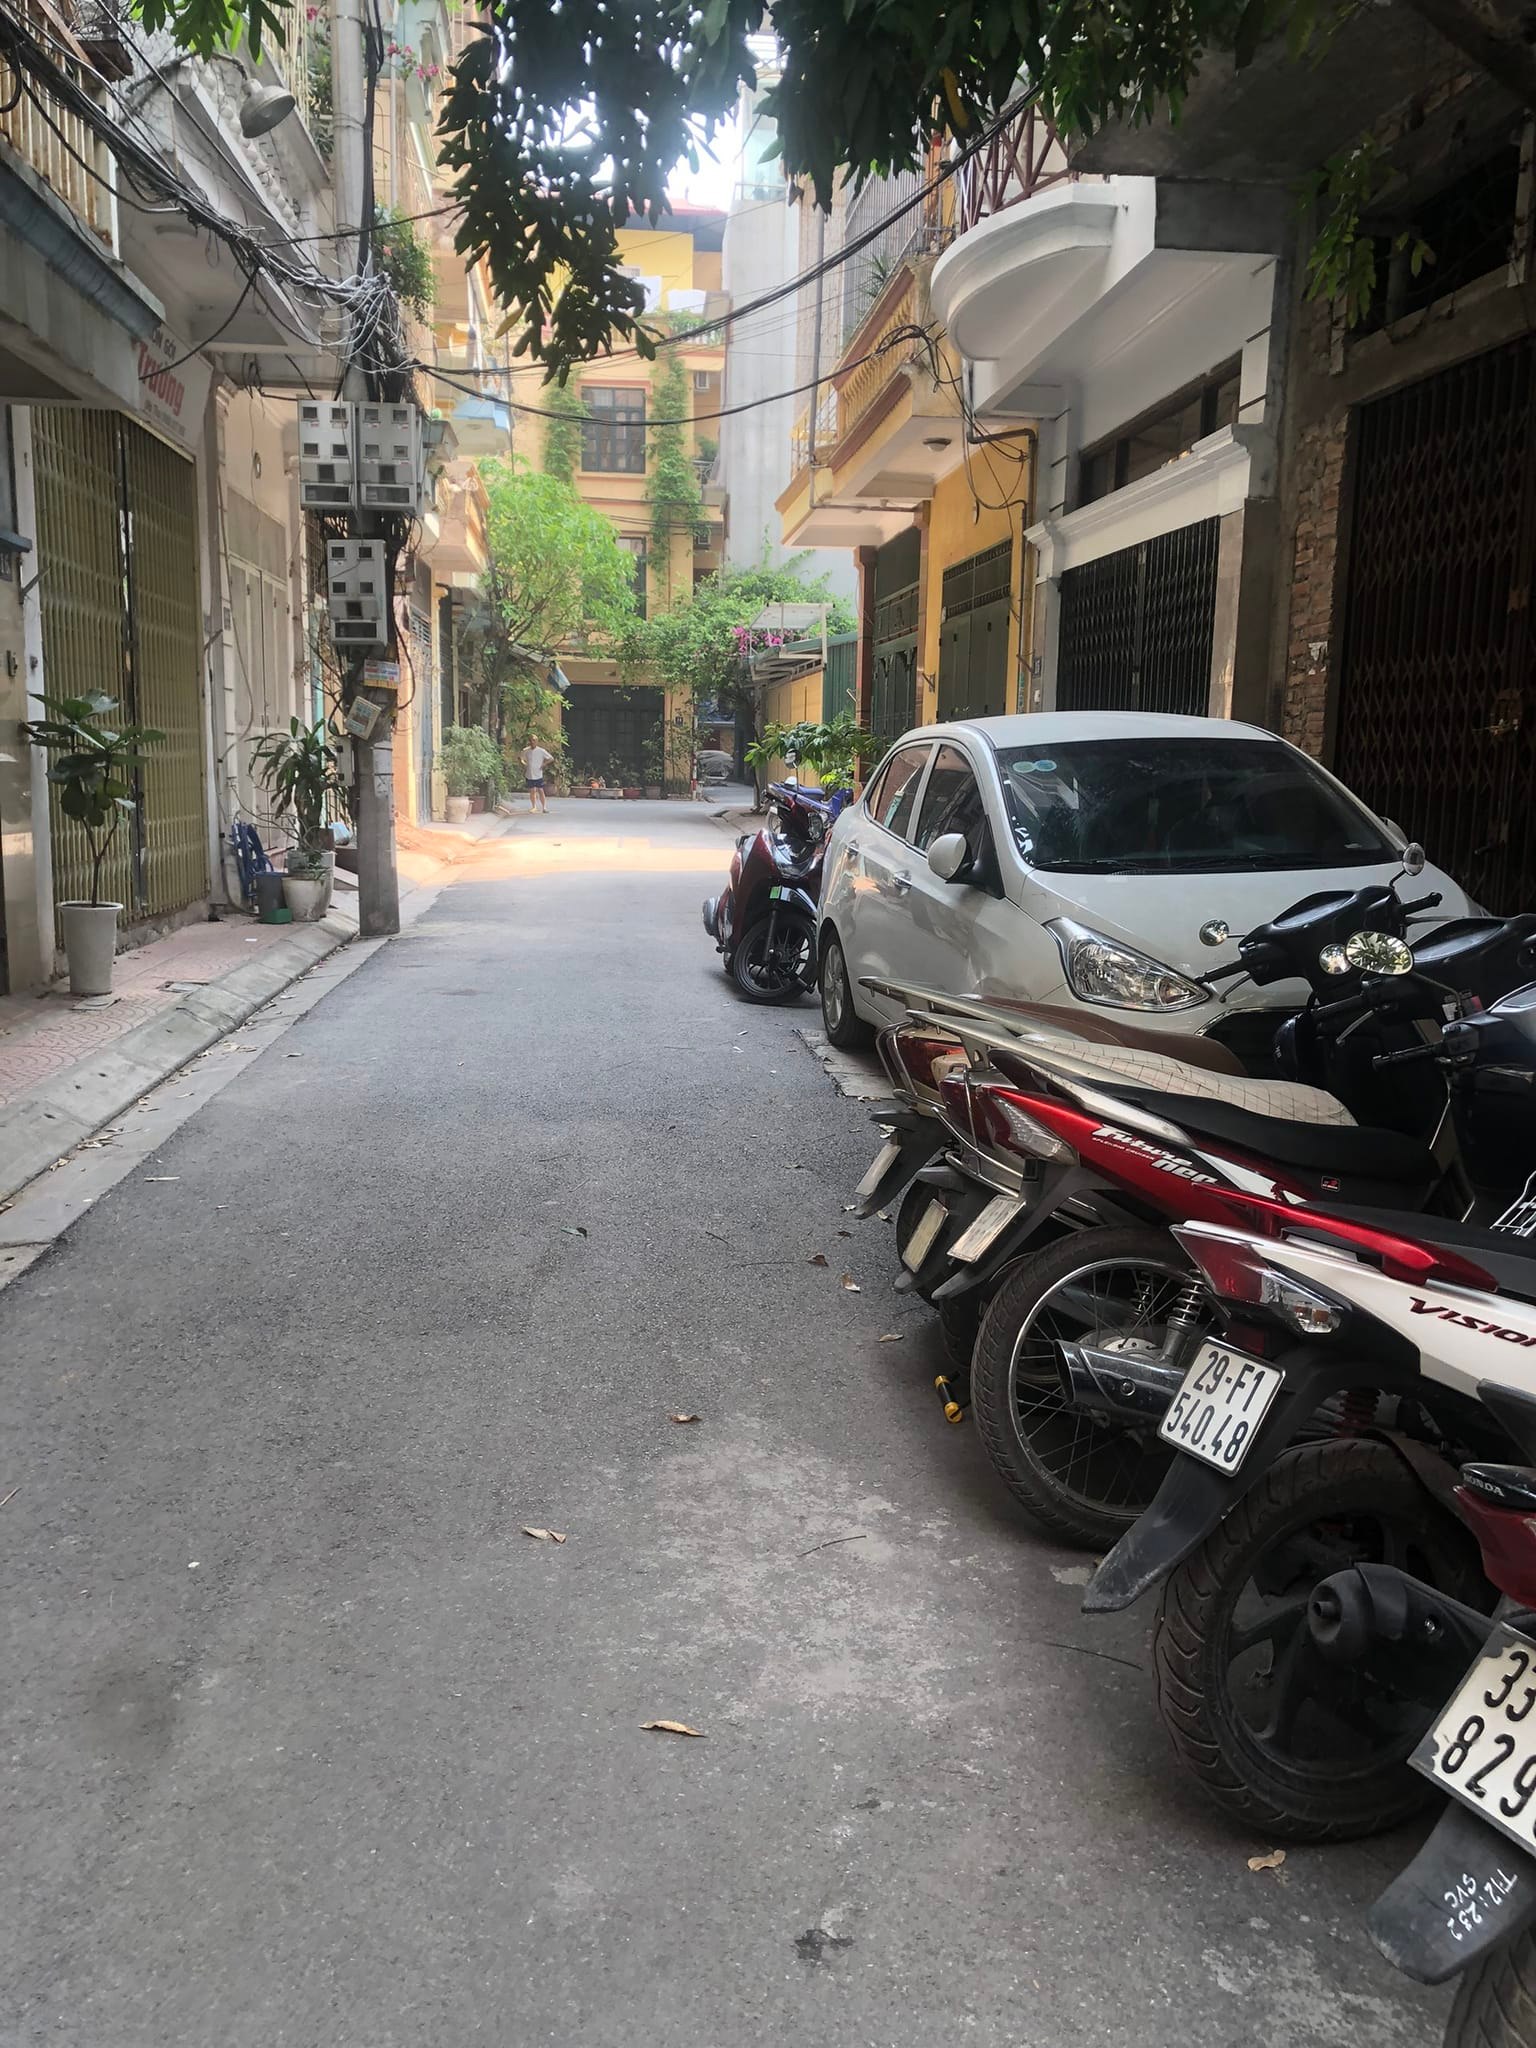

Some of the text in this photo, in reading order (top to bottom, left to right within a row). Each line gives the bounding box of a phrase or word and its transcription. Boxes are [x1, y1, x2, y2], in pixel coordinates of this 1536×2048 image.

[1193, 1350, 1266, 1412] 29-F1
[1167, 1392, 1249, 1463] 540.48
[1463, 1472, 1505, 1497] HONDA
